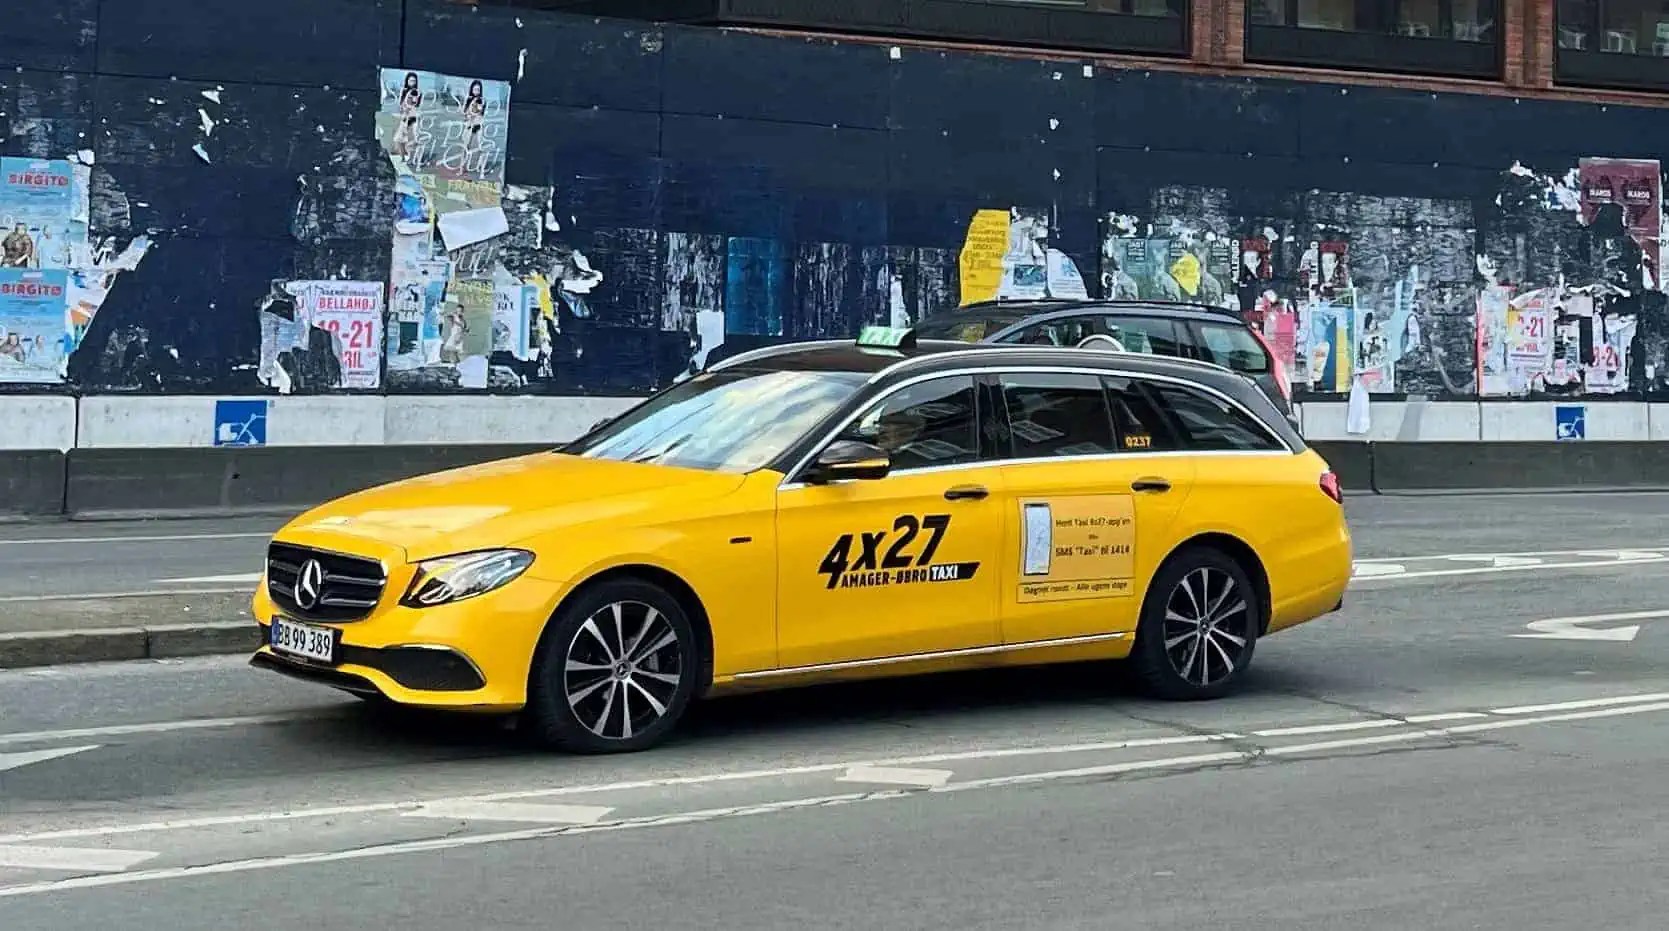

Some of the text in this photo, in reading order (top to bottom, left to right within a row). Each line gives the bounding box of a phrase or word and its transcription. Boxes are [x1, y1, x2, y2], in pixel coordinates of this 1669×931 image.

[931, 565, 959, 580] TAXI
[293, 627, 306, 650] 99
[308, 631, 329, 656] 389
